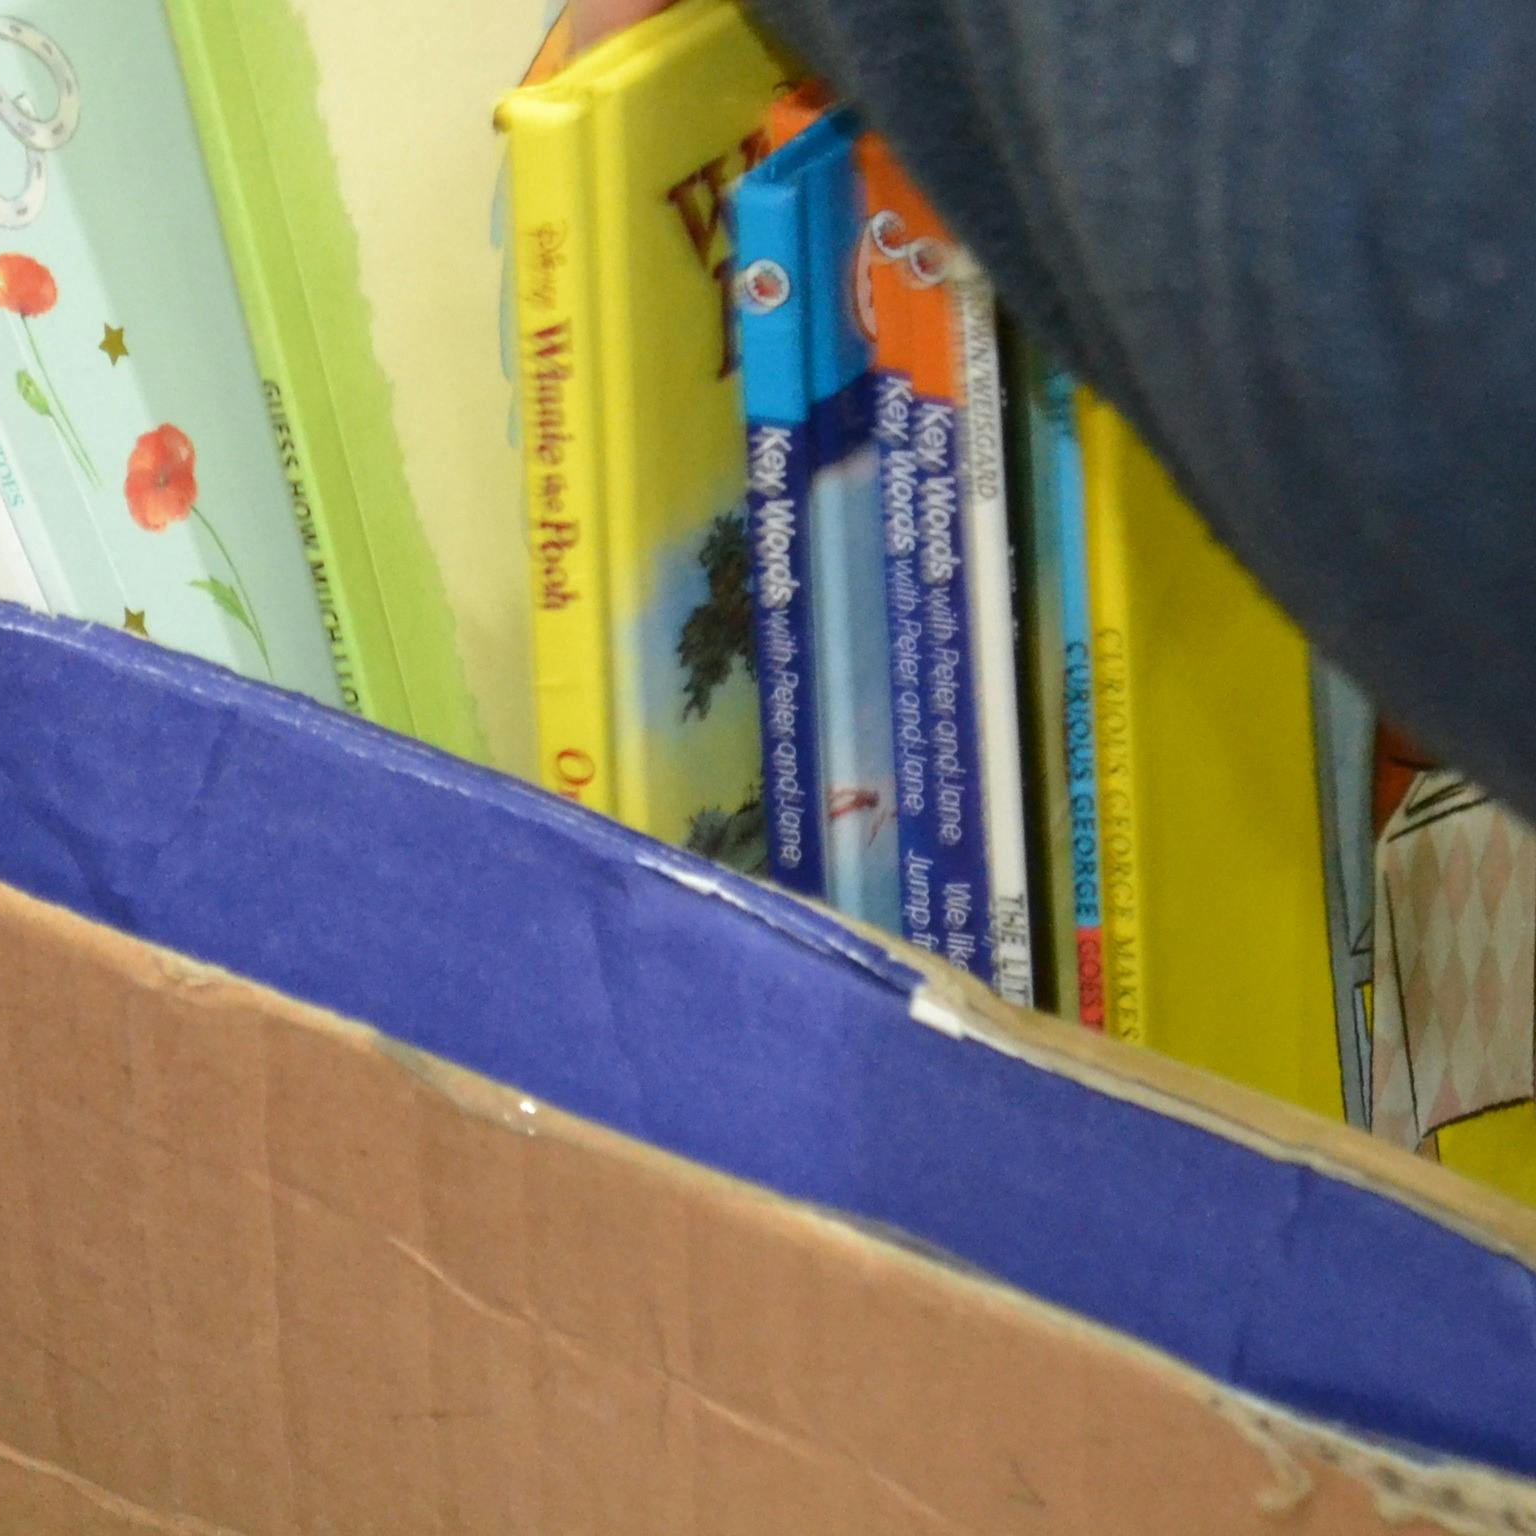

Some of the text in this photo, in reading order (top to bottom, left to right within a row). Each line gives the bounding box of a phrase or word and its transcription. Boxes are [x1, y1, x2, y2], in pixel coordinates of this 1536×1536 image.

[261, 378, 299, 468] GUESS
[290, 477, 320, 552] HOW
[749, 426, 805, 868] Key Words with Peter and Jane
[874, 376, 930, 816] Key Words with Peter and Jane
[919, 399, 969, 847] Key Words with Peter and Jane
[1066, 640, 1094, 785] CURIOUS
[1101, 628, 1128, 774] CURIOUS
[907, 850, 933, 929] Jump
[945, 882, 972, 928] We
[1071, 795, 1098, 918] GEORGE
[1109, 790, 1136, 921] GEORGE
